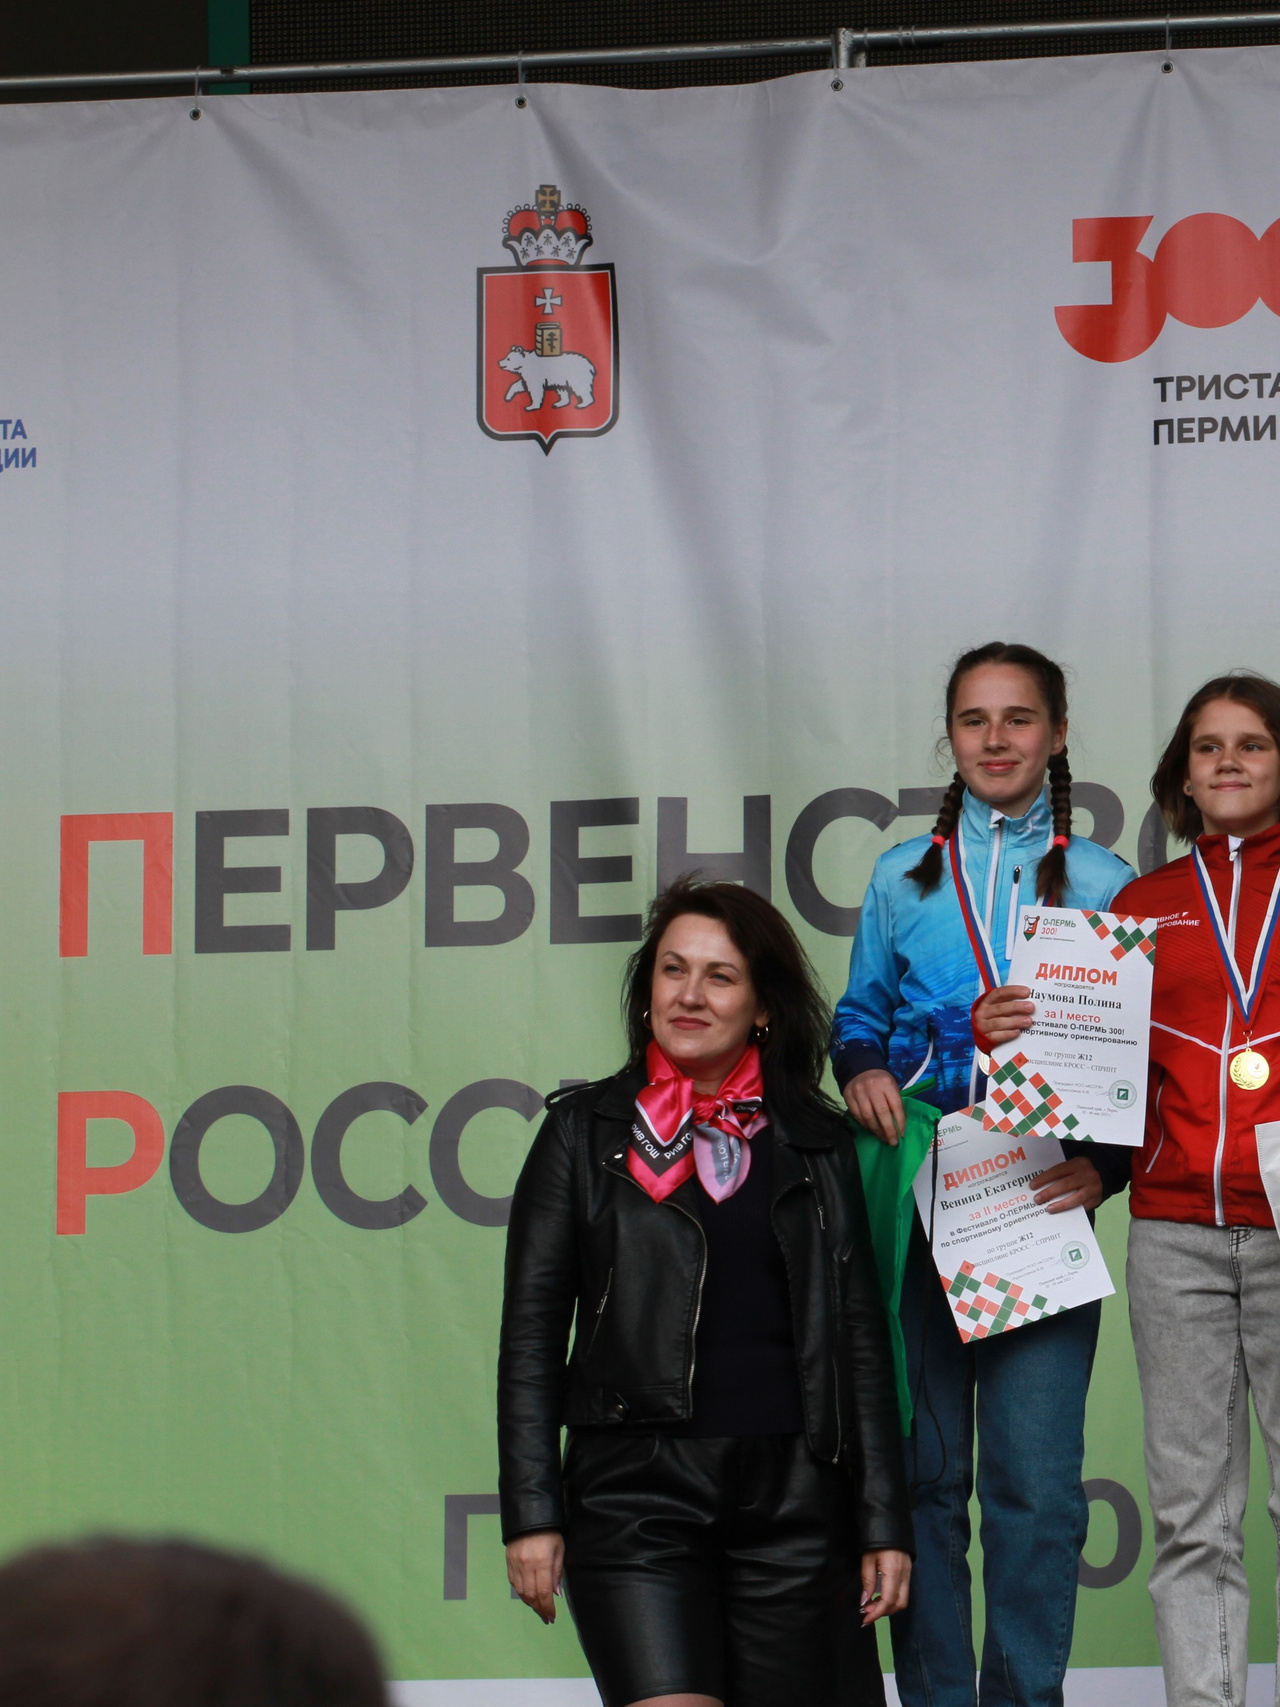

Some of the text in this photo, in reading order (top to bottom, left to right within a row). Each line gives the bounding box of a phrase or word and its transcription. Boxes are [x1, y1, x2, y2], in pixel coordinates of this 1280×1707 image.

[1153, 415, 1277, 445] ПЕРМИ
[0, 447, 36, 473] ИИ
[59, 782, 1170, 958] ПЕРВЕНС
[1041, 927, 1058, 935] 300!
[1043, 918, 1077, 928] О-ПЕРМЬ
[1035, 962, 1118, 986] ДИПЛОМ
[1078, 995, 1122, 1009] Полина
[1044, 1010, 1056, 1018] за
[1067, 1012, 1101, 1023] место
[1032, 1020, 1068, 1030] естивале
[1070, 1023, 1107, 1034] О-ПЕРМЬ
[1020, 1028, 1138, 1046] портивному ориентированию
[1077, 1052, 1093, 1061] Ж12
[681, 1131, 694, 1146] ГО
[56, 1078, 588, 1236] РОСС
[943, 1146, 1026, 1191] ДИПЛОМ
[940, 1192, 982, 1211] Венина
[968, 1212, 982, 1221] за
[994, 1194, 1028, 1212] место
[956, 1217, 998, 1234] Фестивале
[952, 1226, 1002, 1245] спортивному
[1018, 1232, 1034, 1242] Ж12
